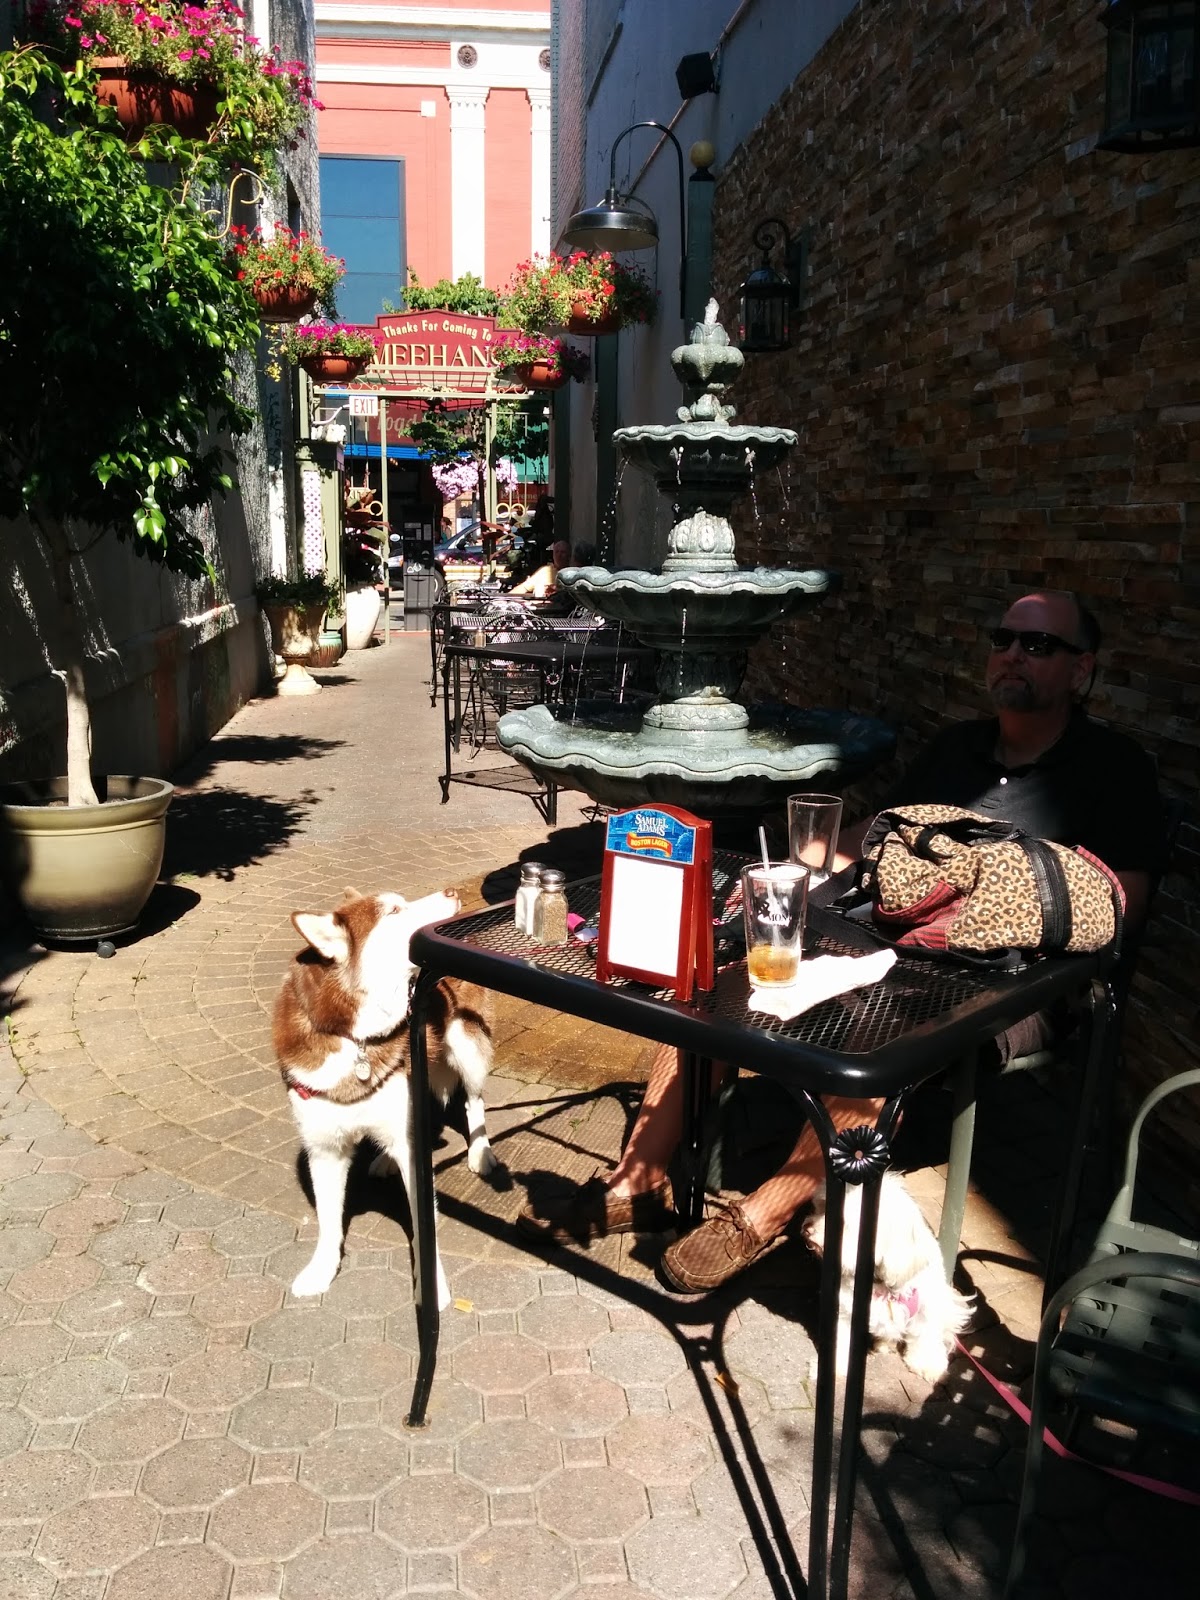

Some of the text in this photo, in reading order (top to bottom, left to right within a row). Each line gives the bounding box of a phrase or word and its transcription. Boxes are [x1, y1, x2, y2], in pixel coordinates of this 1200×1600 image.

[382, 319, 492, 341] Thanks For Coming To
[353, 398, 375, 414] EXIT
[635, 814, 669, 829] SAMUEL
[636, 824, 666, 837] ADAMS
[630, 839, 668, 849] BOSTON LAGER
